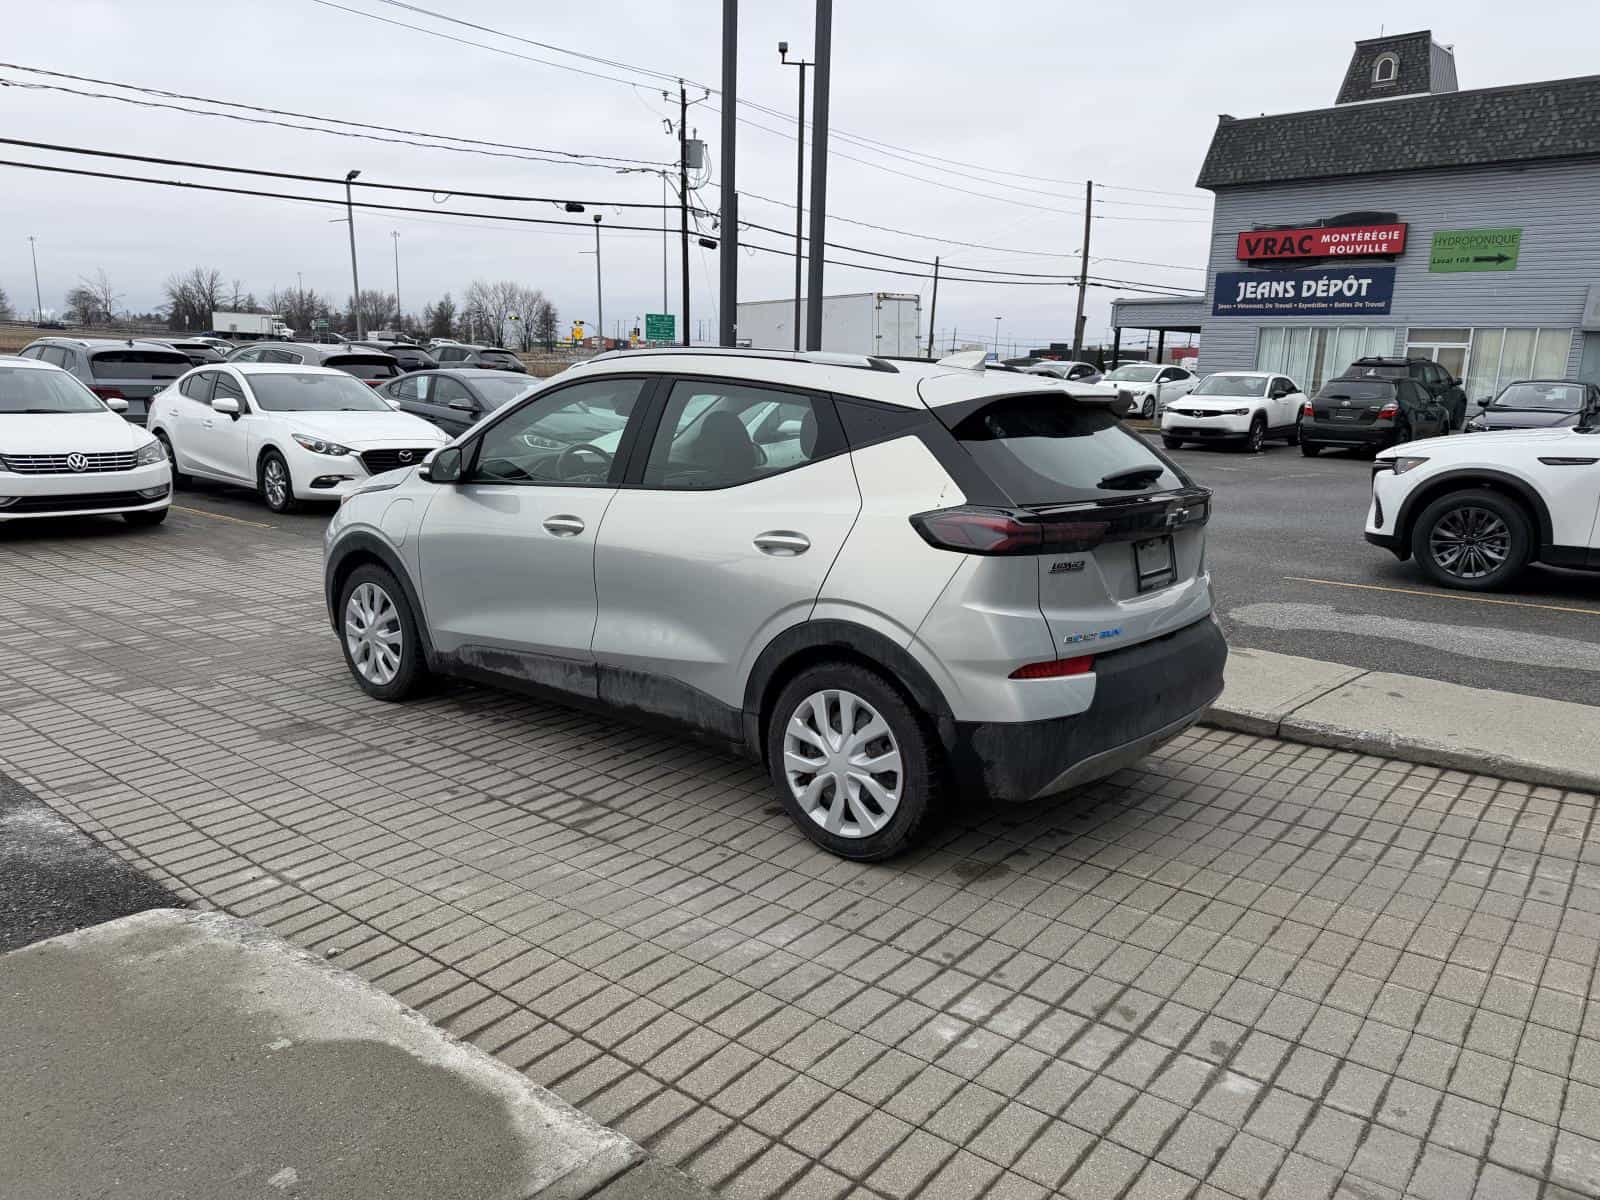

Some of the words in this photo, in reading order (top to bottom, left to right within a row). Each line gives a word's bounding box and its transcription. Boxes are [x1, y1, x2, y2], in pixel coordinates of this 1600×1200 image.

[1321, 230, 1400, 243] MONTÉRÉGIE
[1434, 233, 1518, 247] HYDROPONIQUE
[1245, 235, 1313, 256] VRAC
[1329, 243, 1388, 254] ROUVILLE
[1236, 281, 1295, 301] JEANS
[1302, 275, 1372, 297] DÉPÔT
